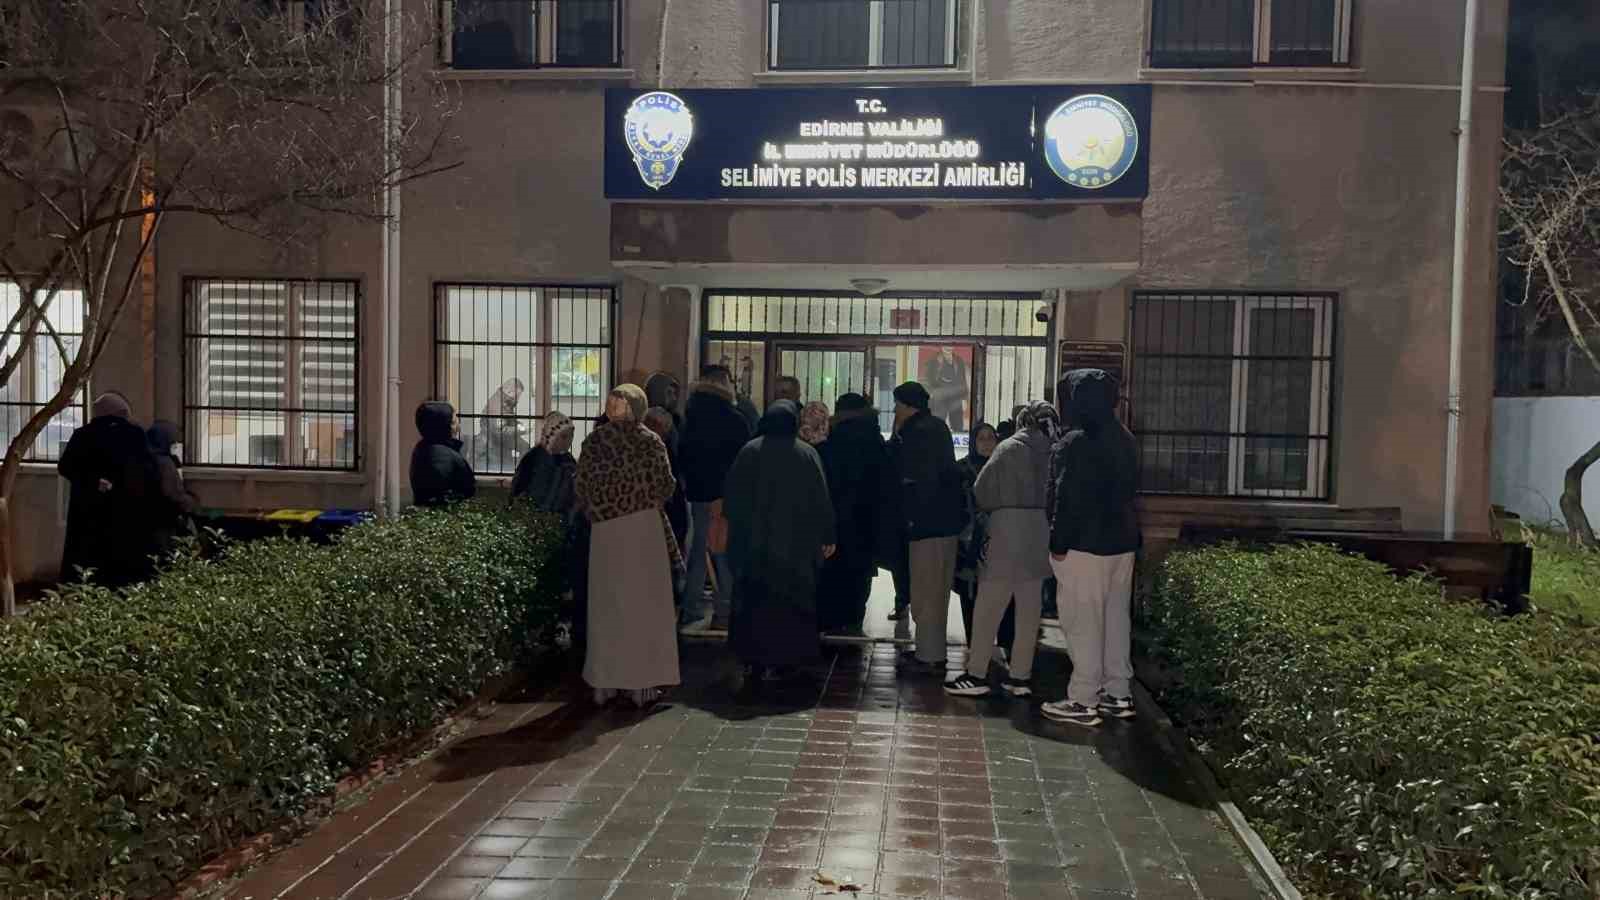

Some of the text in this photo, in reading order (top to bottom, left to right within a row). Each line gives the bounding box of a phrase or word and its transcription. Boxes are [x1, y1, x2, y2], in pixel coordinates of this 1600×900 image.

[856, 99, 887, 113] T.C.
[800, 119, 864, 137] EDİRNE
[721, 162, 1025, 187] SELİMİYE POLİS MERKEZİ AMİRLİĞİ
